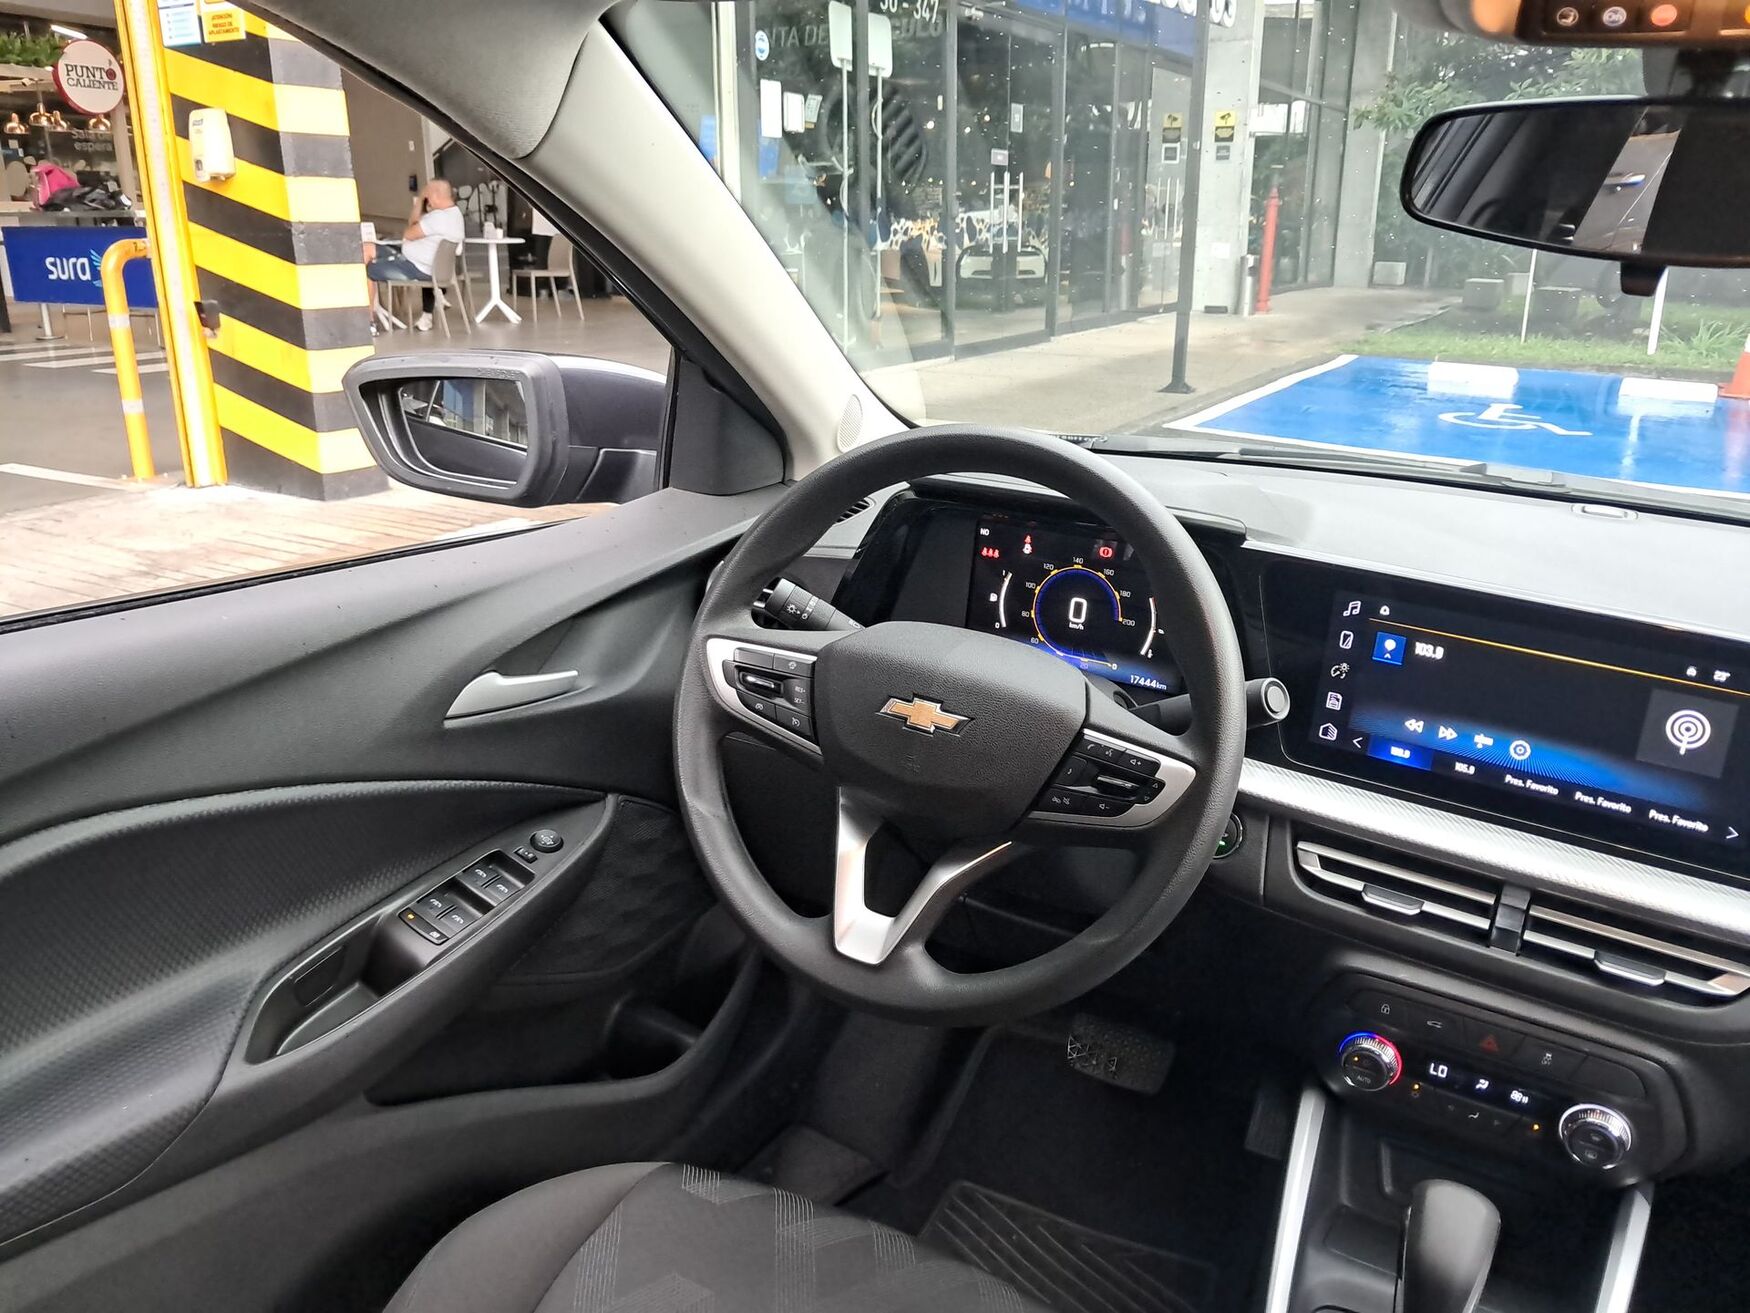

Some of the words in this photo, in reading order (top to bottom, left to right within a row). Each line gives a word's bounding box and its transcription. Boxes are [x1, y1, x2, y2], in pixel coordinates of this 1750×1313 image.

[64, 62, 117, 81] PUNTO
[66, 77, 119, 91] CALIENTE
[45, 256, 91, 281] sura
[1043, 563, 1055, 571] 120
[1021, 610, 1030, 618] 80
[1069, 597, 1088, 623] 0
[1069, 622, 1085, 631] km/h
[1122, 619, 1136, 627] 200
[1504, 774, 1524, 788] Pres.
[1525, 779, 1559, 796] Favorito
[1574, 791, 1595, 805] Pres.
[1596, 796, 1632, 814] Favorito
[1649, 809, 1670, 823] Pres.
[1671, 815, 1709, 833] Favorito
[1356, 1075, 1371, 1084] AUTO
